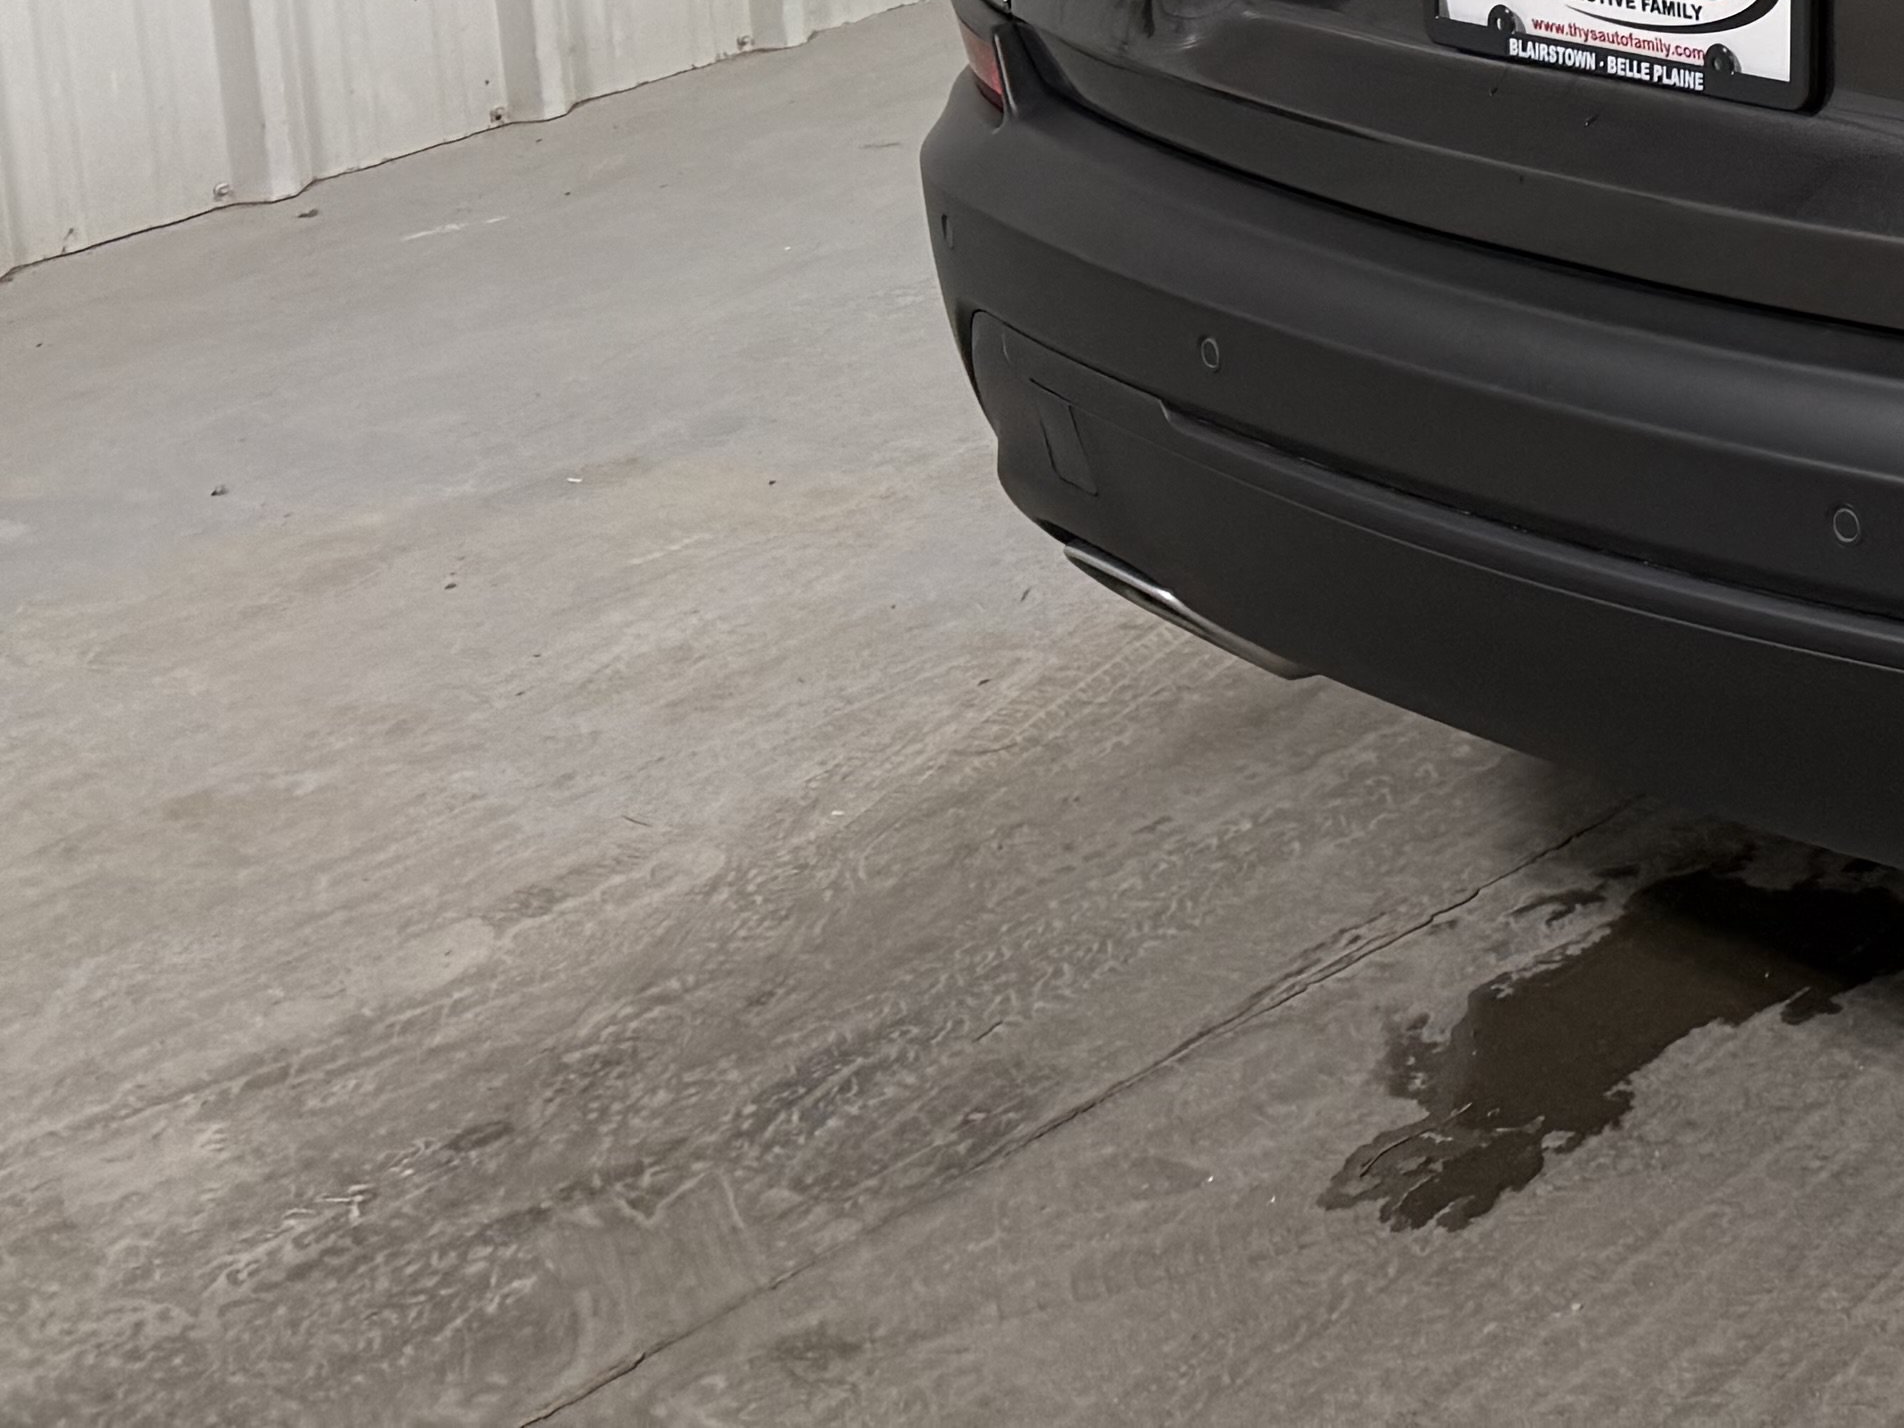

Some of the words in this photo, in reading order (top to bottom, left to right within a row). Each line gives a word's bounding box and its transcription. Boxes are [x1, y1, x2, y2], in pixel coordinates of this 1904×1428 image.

[1532, 18, 1705, 60] www.thysautofamily.com
[1509, 38, 1596, 70] BLAIRSTOWN
[1607, 56, 1650, 81] BELLE
[1652, 65, 1704, 91] PLAINE
